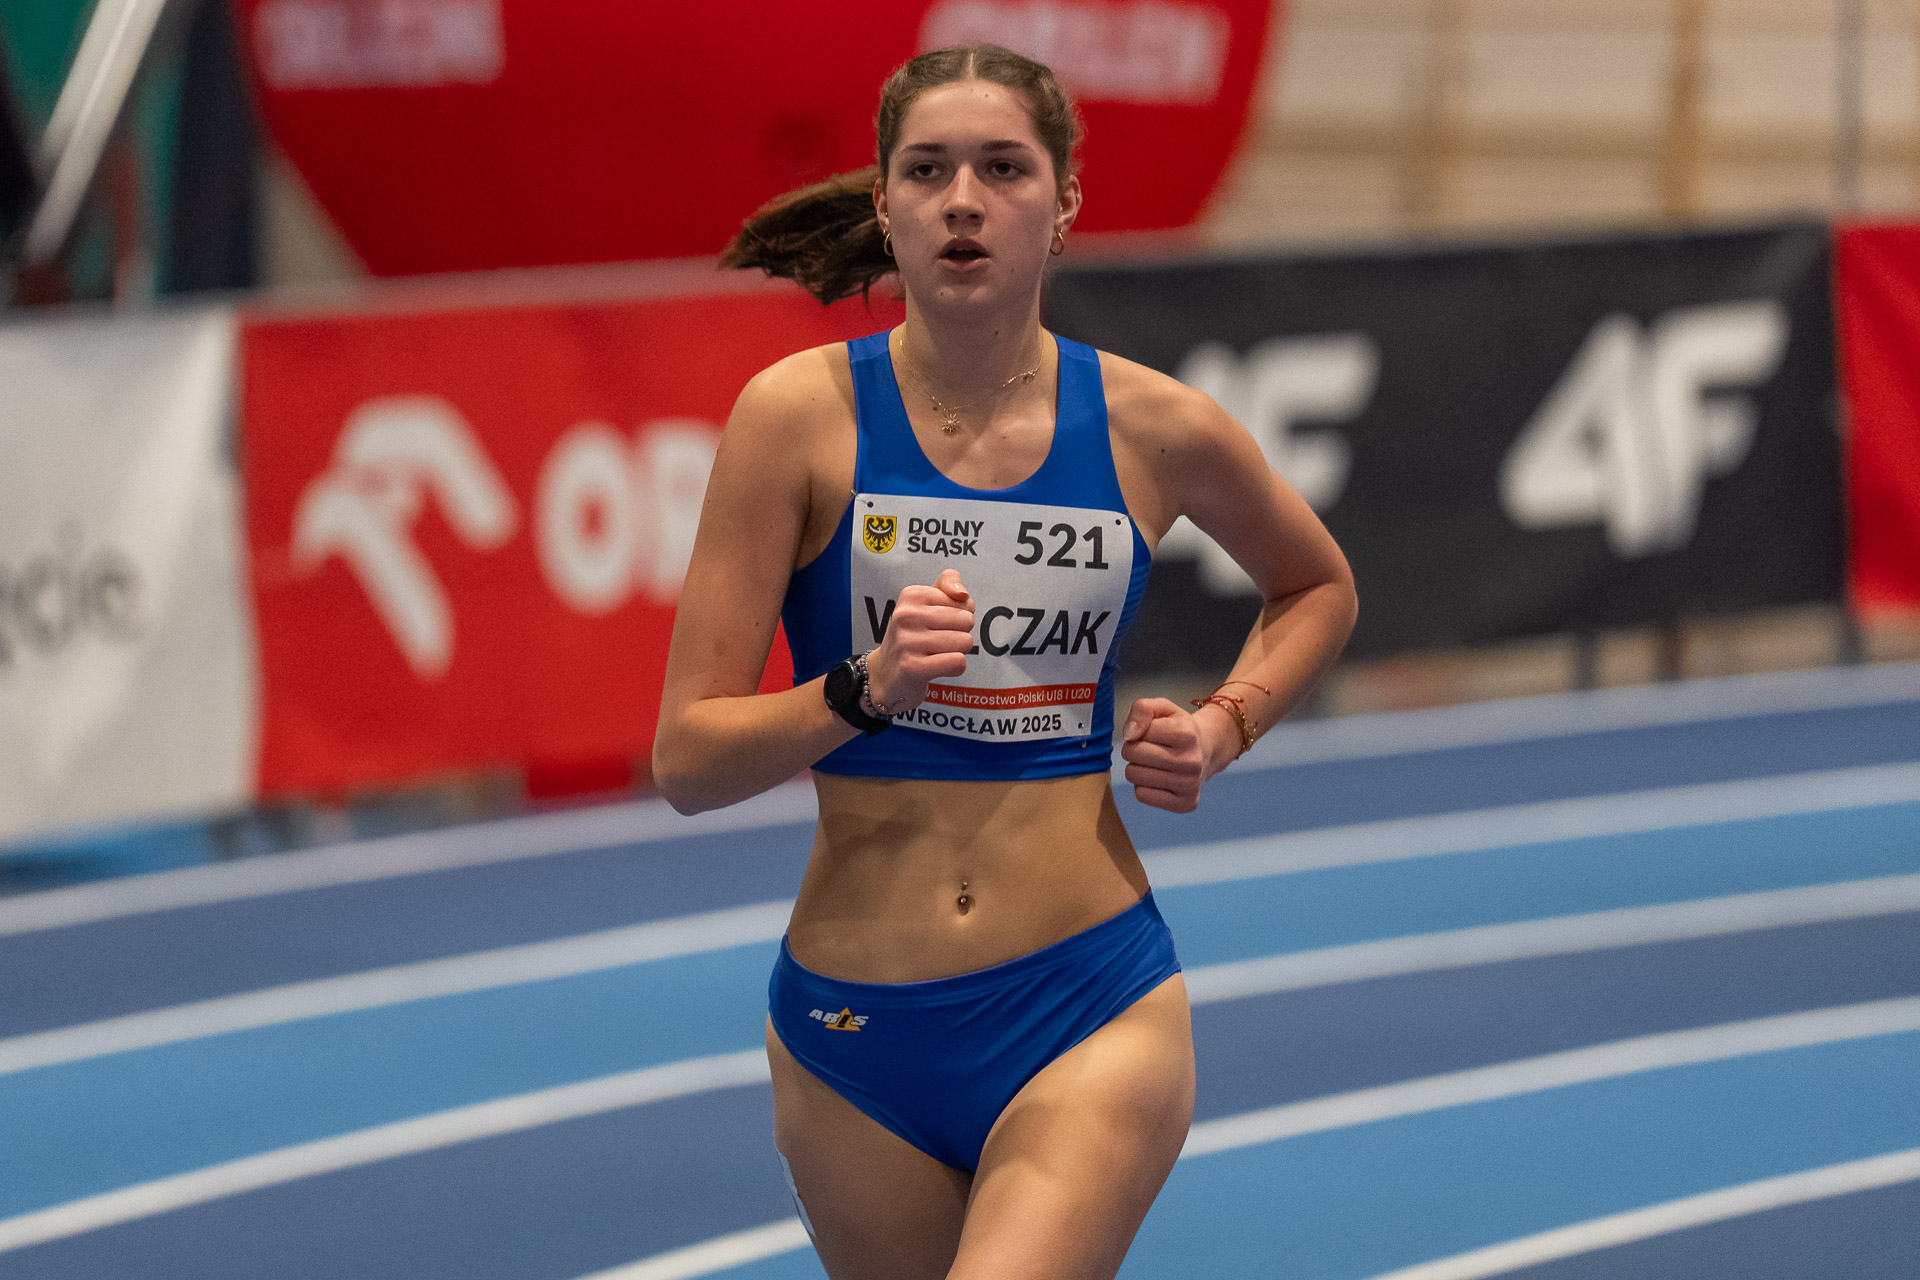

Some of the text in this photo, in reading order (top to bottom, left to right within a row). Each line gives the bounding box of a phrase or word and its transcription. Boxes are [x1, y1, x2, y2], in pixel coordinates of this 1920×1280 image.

[1500, 303, 1792, 557] 4F
[908, 517, 985, 538] DOLNY
[906, 532, 978, 557] ŚLĄSK
[1013, 520, 1109, 570] 521
[864, 595, 1111, 657] WCZAK
[942, 688, 1016, 705] Mistrzostwa
[1018, 692, 1045, 704] Polski
[1046, 690, 1063, 701] U18
[1071, 688, 1091, 699] U20
[896, 708, 1062, 736] WROCŁAW 2025
[808, 1008, 869, 1028] ABIS
